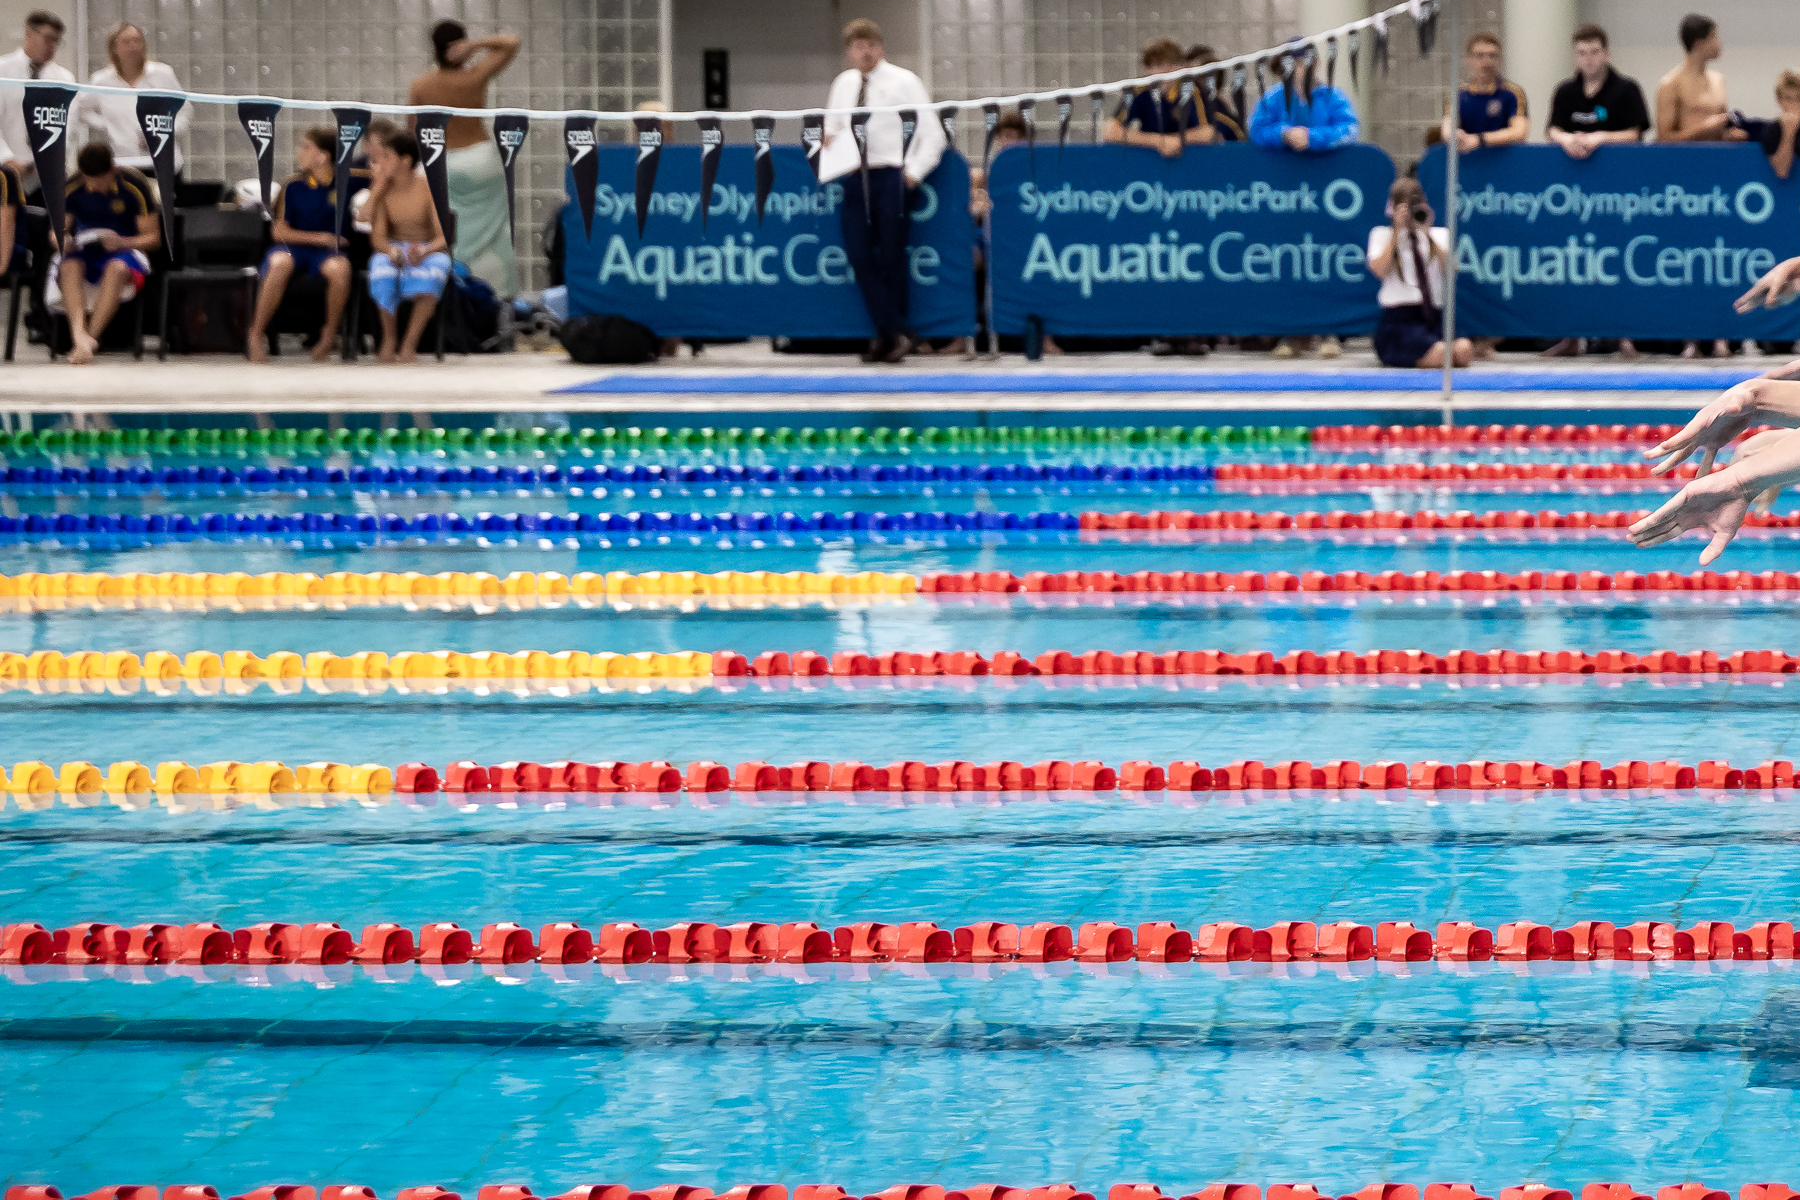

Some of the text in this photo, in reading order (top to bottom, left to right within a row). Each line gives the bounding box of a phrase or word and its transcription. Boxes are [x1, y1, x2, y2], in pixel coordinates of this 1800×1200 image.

[599, 232, 779, 300] Aquatic
[1021, 229, 1366, 298] Aquatic Centre
[1455, 232, 1776, 300] Aquatic Centre
